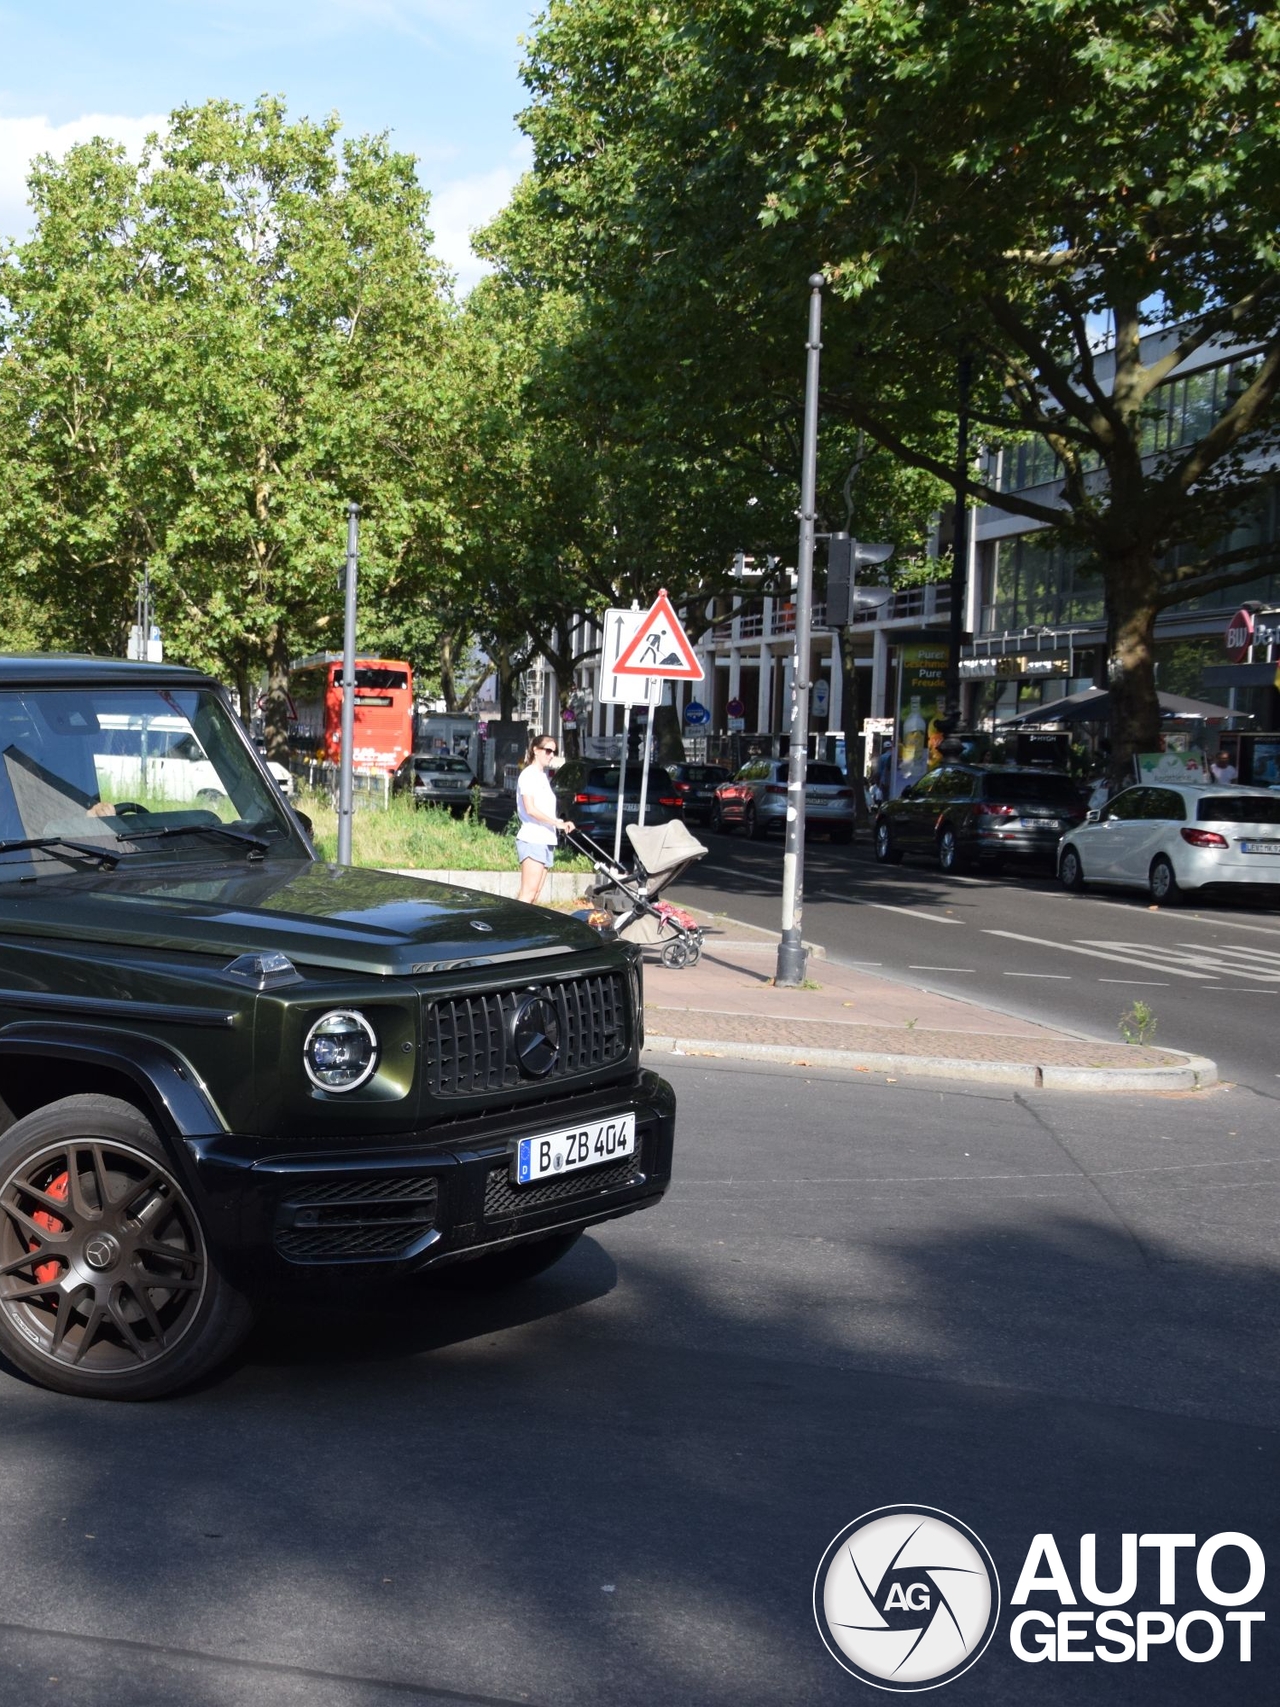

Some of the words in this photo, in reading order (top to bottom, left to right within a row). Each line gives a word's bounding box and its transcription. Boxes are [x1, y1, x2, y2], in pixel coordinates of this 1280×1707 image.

[919, 669, 942, 678] Pure
[539, 1140, 552, 1173] B
[565, 1131, 590, 1166] ZB
[593, 1121, 628, 1157] 404
